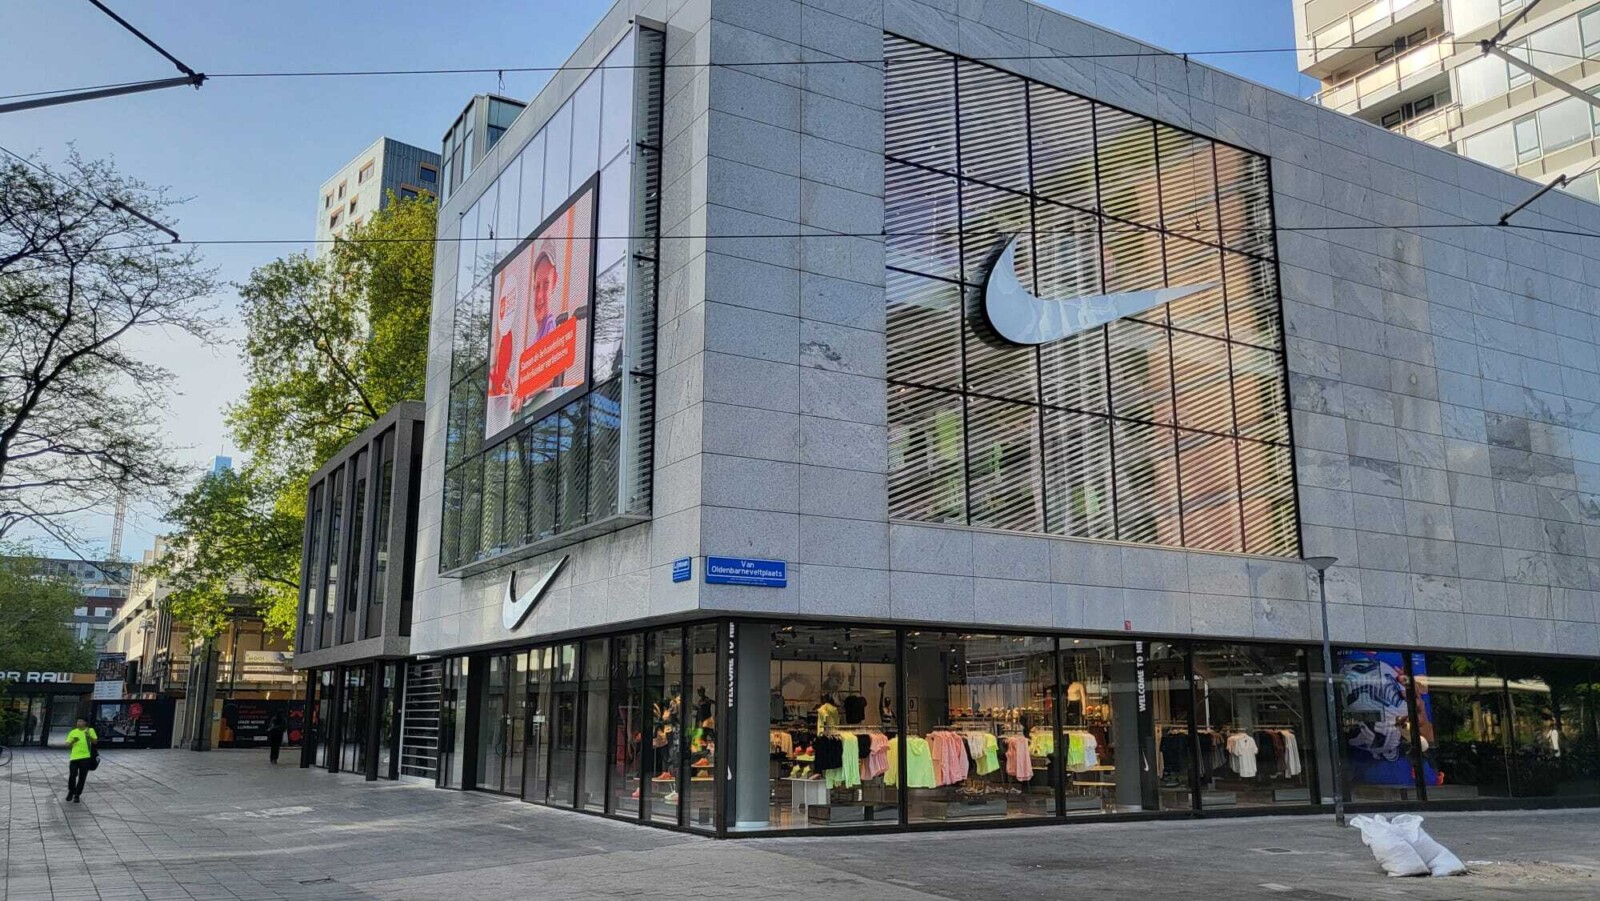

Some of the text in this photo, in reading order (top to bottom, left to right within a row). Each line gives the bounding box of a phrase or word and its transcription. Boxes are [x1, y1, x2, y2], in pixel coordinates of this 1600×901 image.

[711, 566, 783, 577] Oldenbarneveltplaats
[1136, 656, 1144, 667] TO
[26, 671, 73, 684] RAW
[1137, 670, 1146, 712] WELCOME
